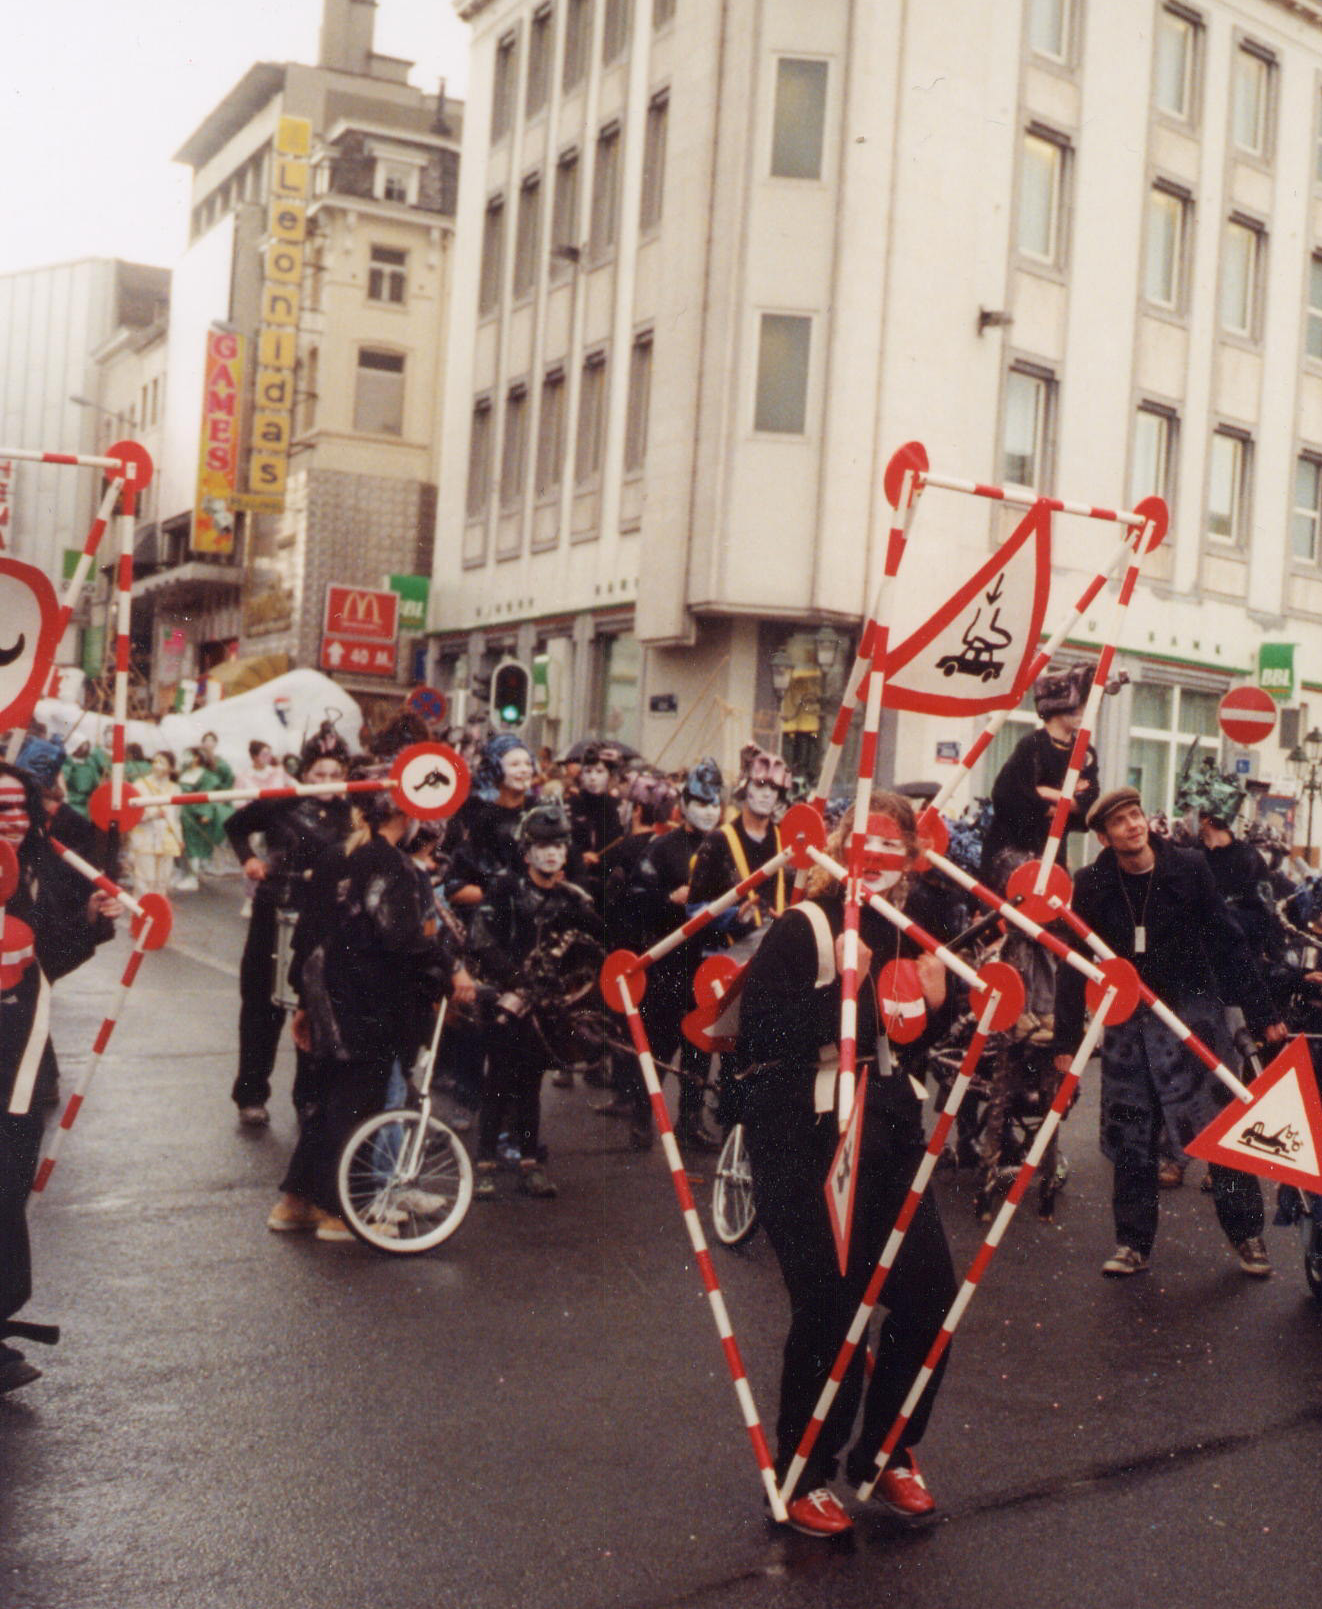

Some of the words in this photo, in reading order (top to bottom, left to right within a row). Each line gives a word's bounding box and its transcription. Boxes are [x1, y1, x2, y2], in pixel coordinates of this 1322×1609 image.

[260, 164, 301, 484] Leonidas
[205, 333, 239, 473] GAMES
[350, 647, 370, 666] 40
[1260, 667, 1293, 688] BBL
